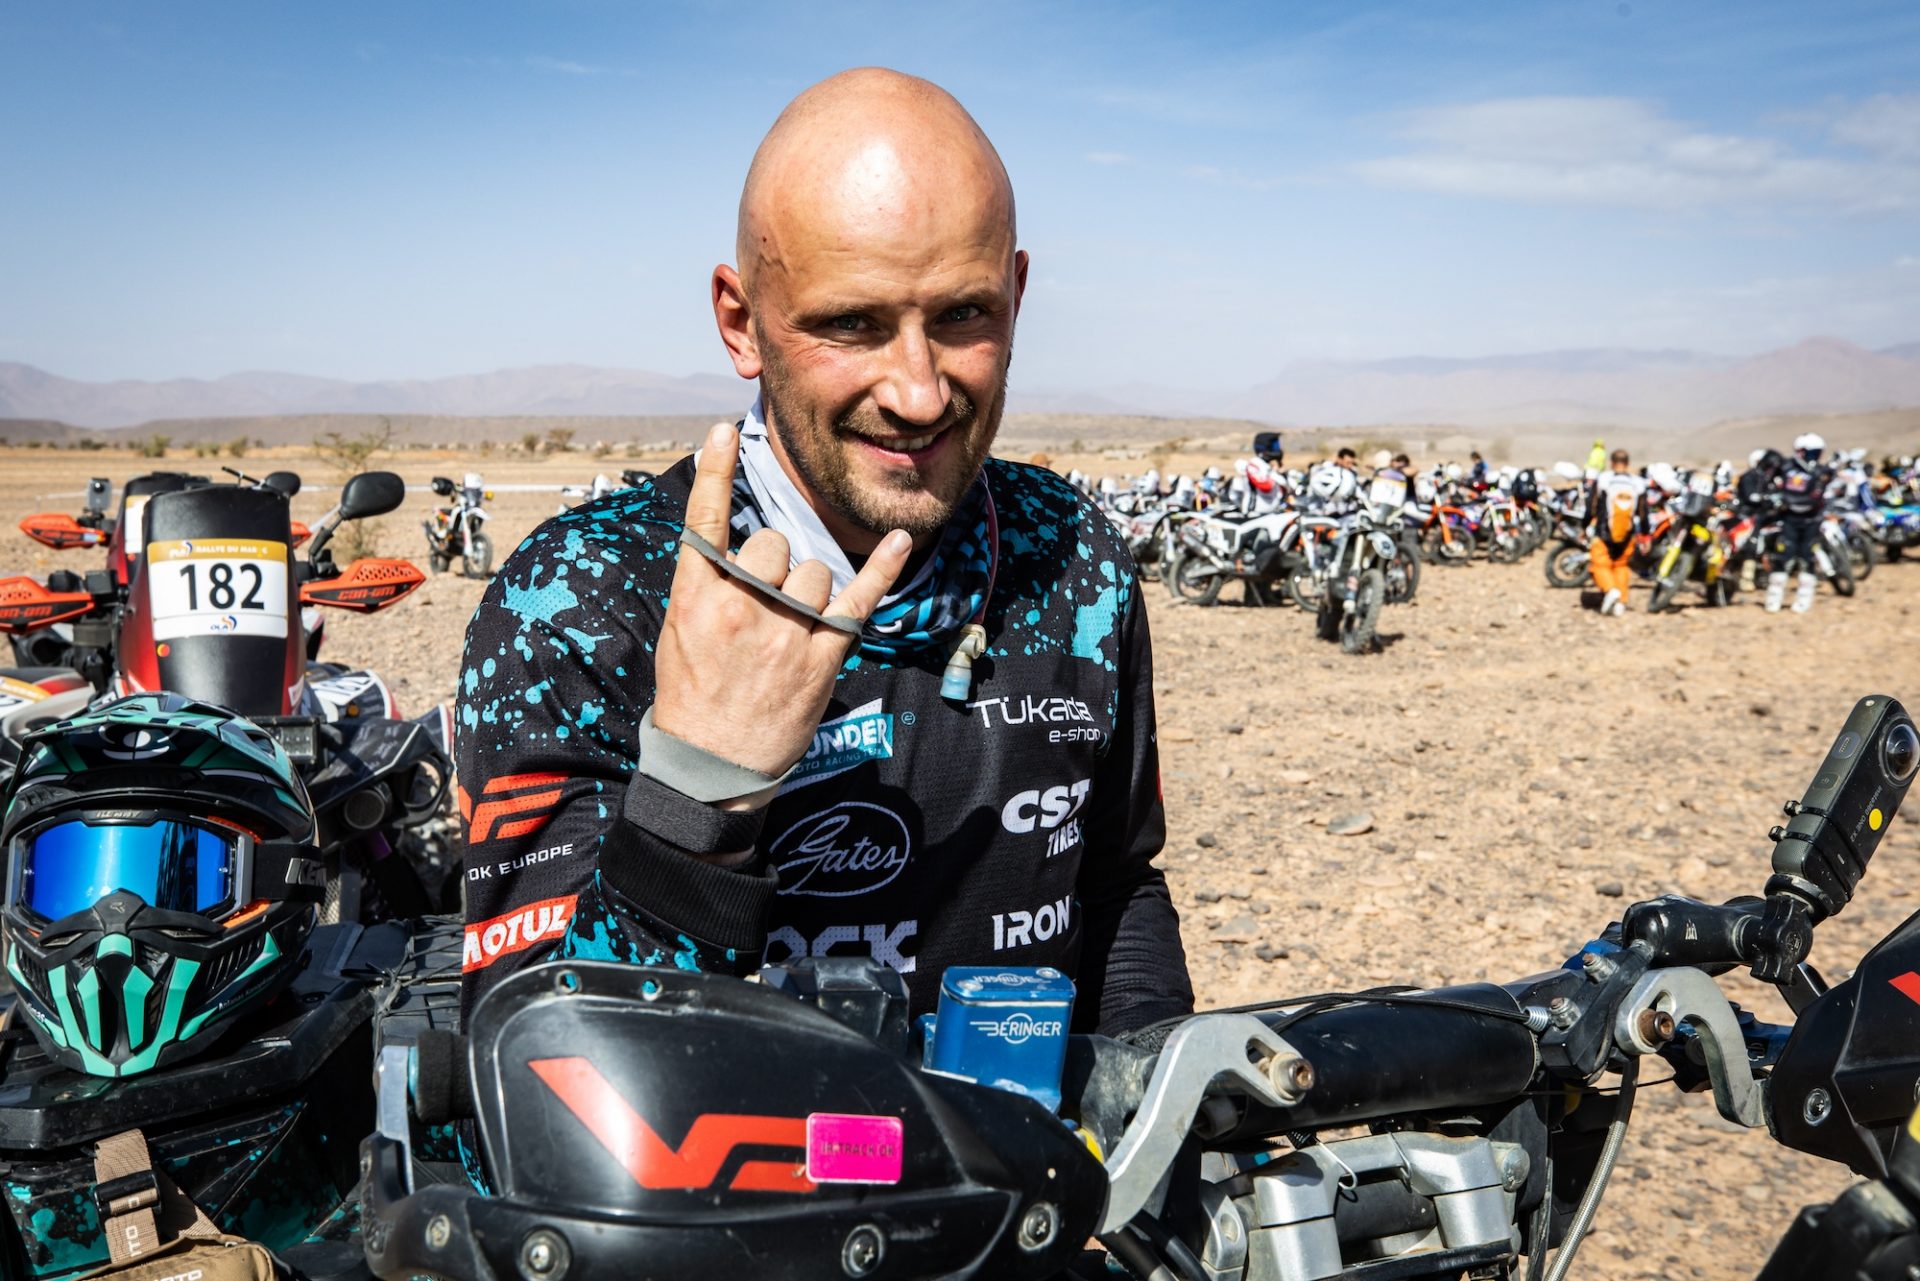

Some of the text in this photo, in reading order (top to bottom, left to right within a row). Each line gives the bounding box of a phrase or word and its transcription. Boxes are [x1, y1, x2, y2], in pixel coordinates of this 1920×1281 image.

[179, 562, 265, 611] 182
[804, 718, 893, 760] UNDER
[1001, 778, 1091, 834] CST
[498, 843, 574, 876] EUROPE
[787, 814, 903, 893] Gates
[1045, 817, 1080, 859] TIRES
[462, 904, 568, 967] MOTUL
[992, 895, 1070, 951] IRON
[970, 1020, 1062, 1038] BERINGER
